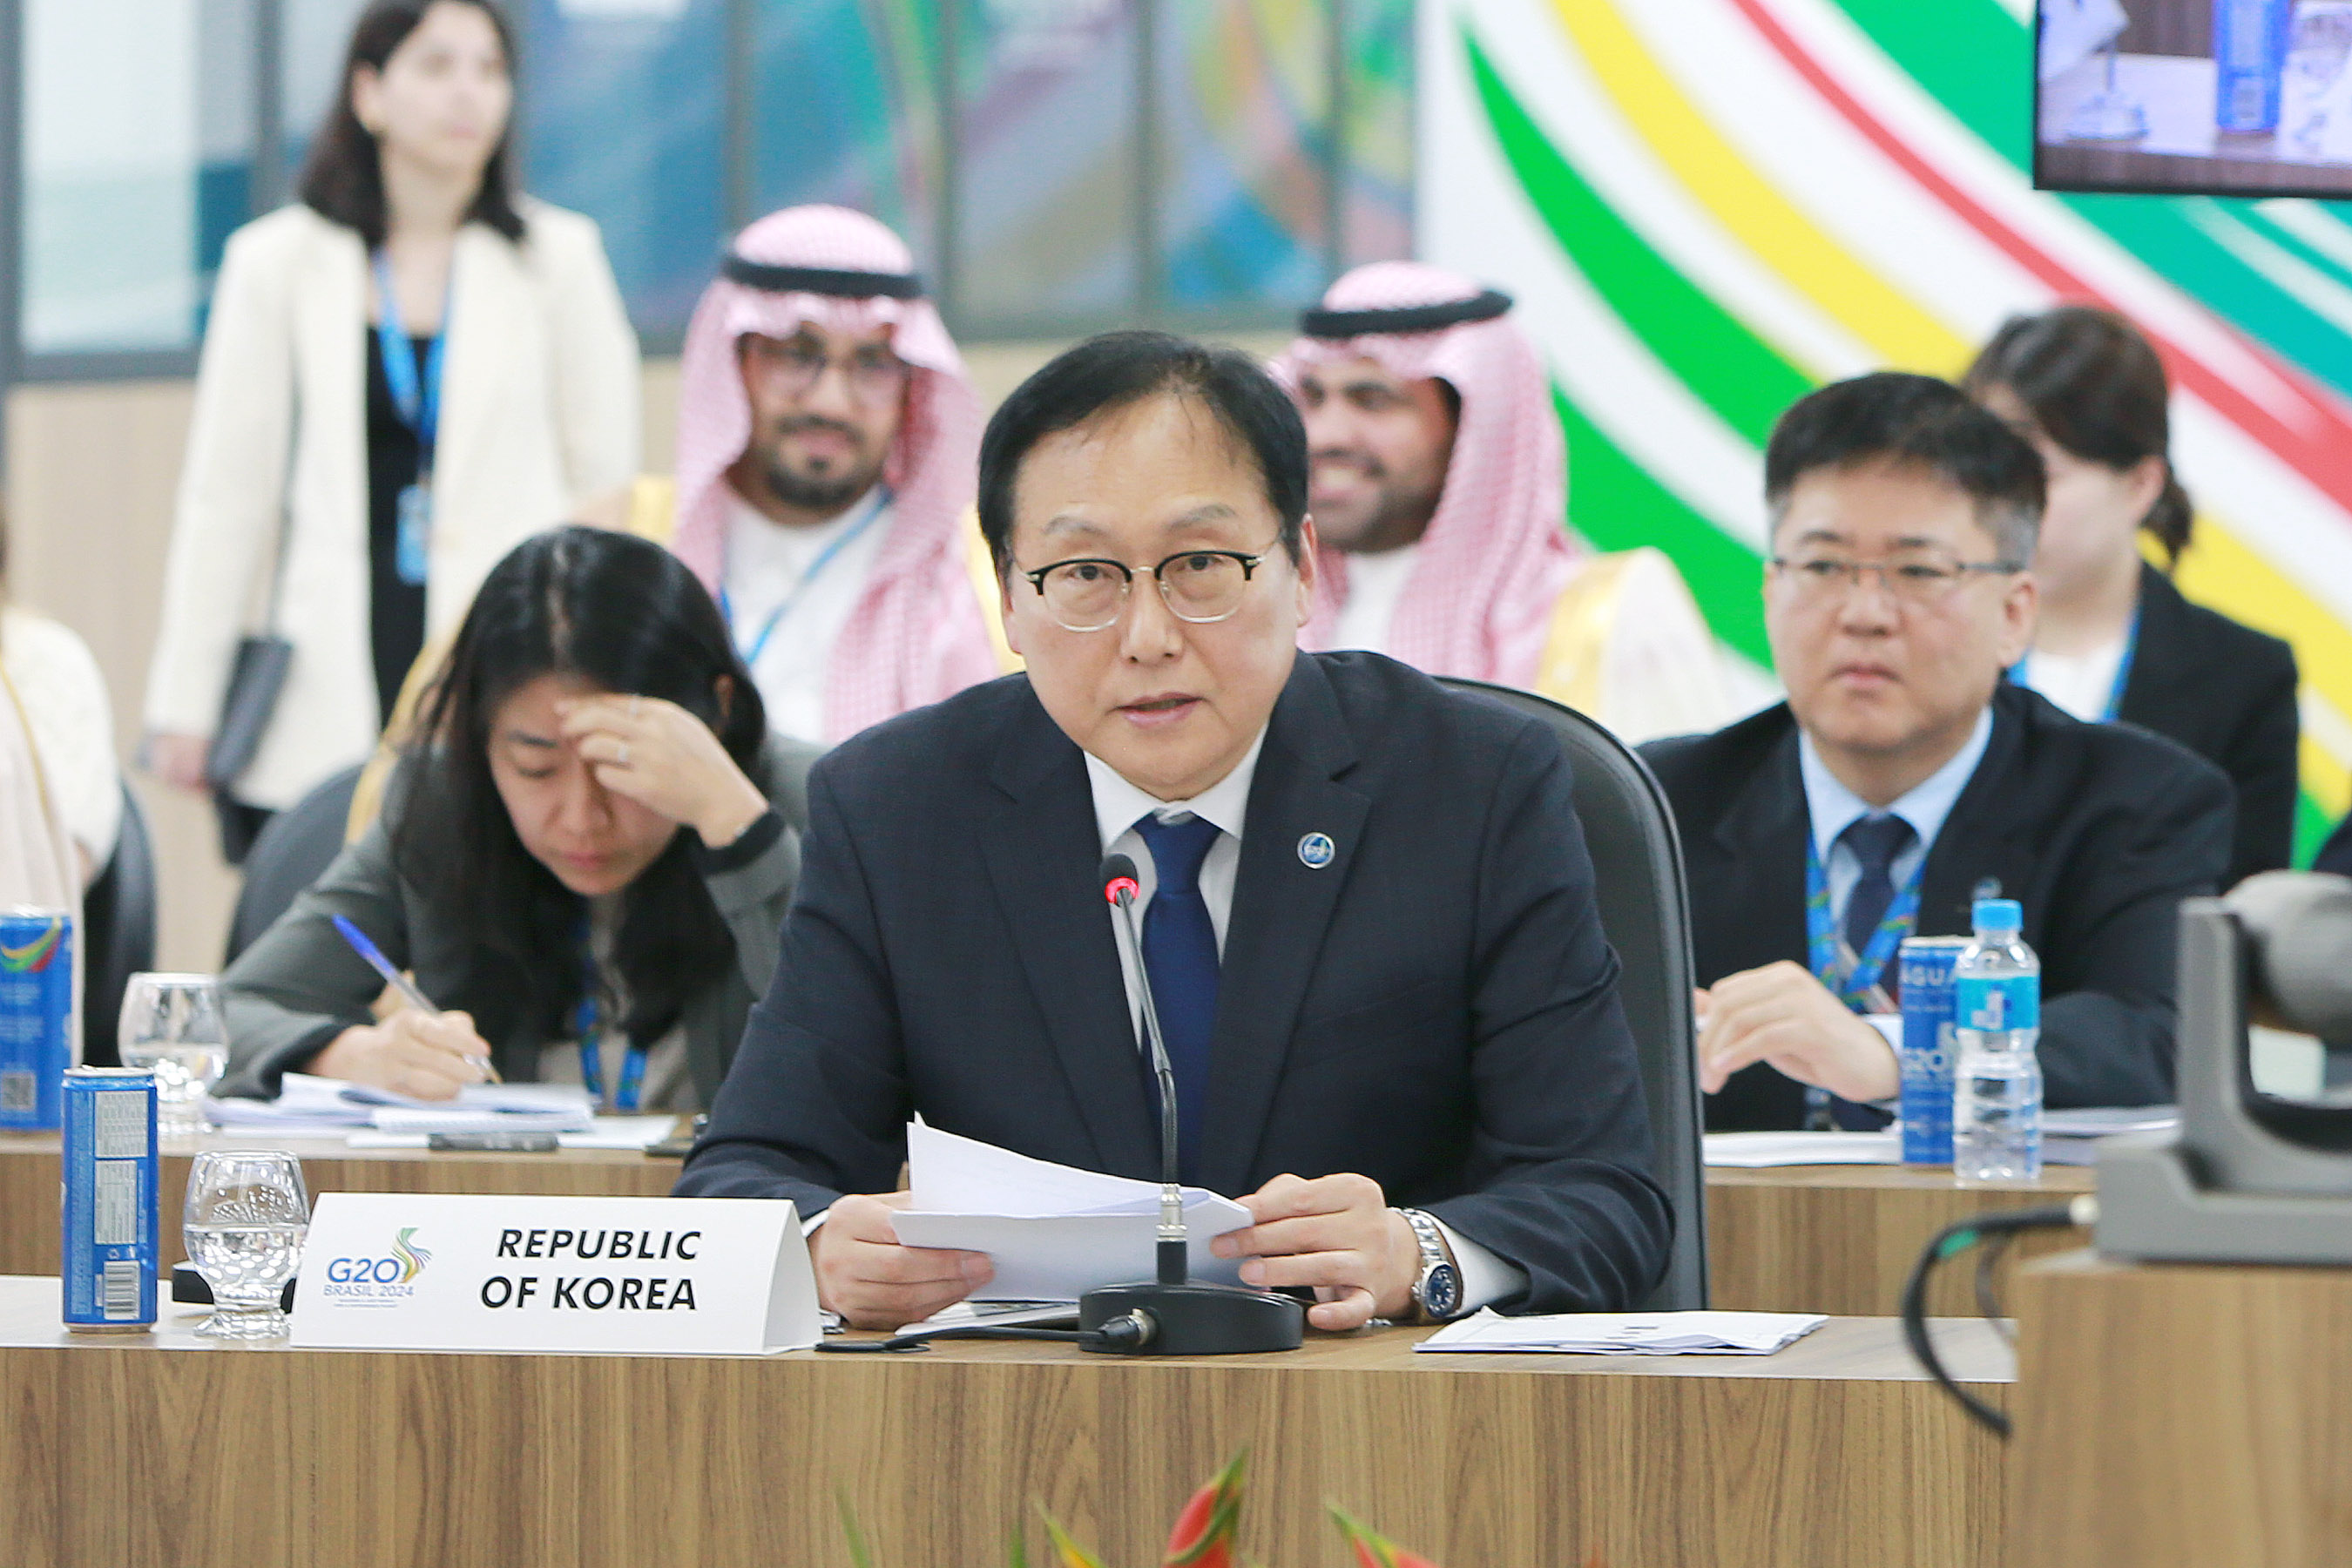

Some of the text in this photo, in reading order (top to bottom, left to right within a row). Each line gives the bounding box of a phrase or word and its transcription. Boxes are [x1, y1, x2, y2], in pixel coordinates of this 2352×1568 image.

[497, 1228, 701, 1260] REPUBLIC
[328, 1258, 400, 1283] G20
[323, 1284, 415, 1297] BRASIL 2024
[481, 1275, 696, 1310] OF KOREA
